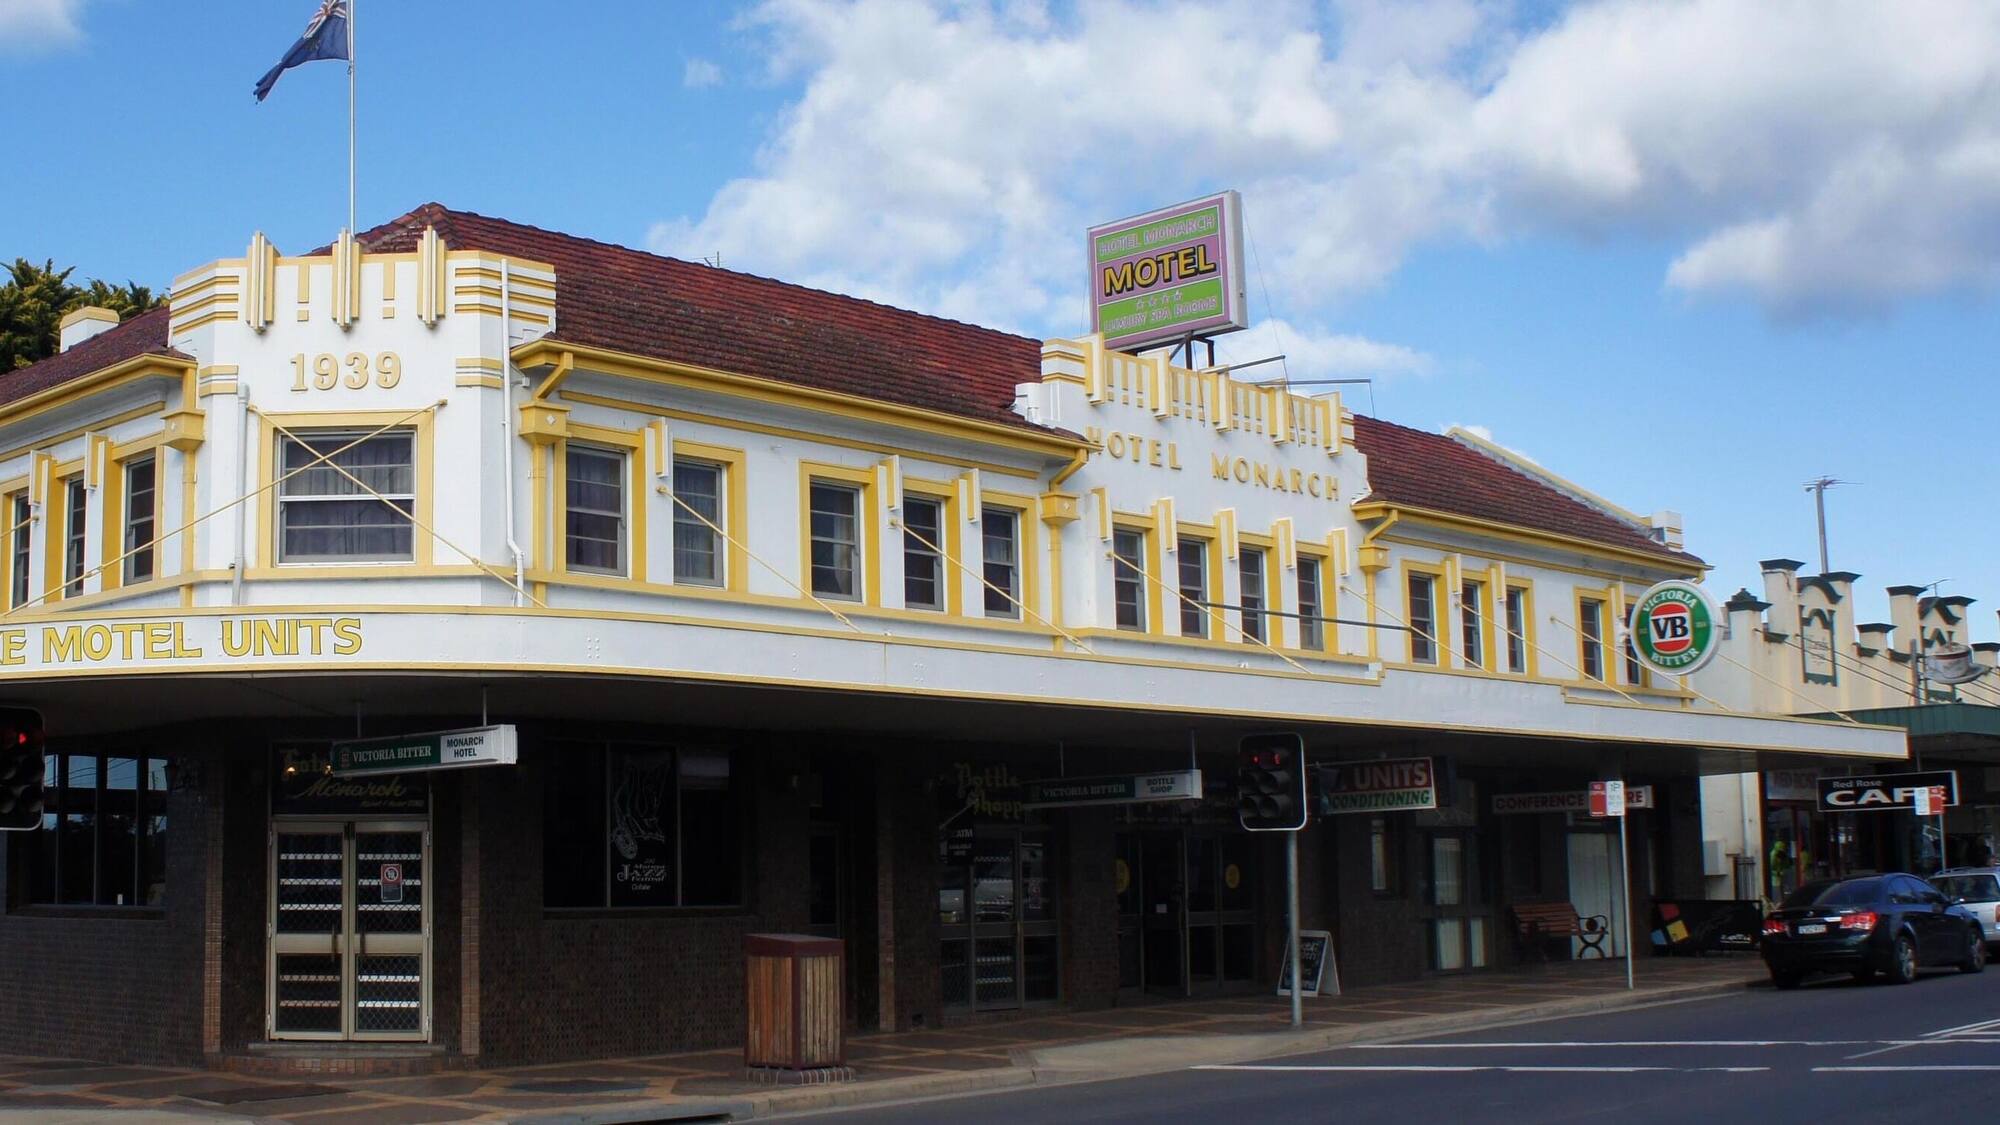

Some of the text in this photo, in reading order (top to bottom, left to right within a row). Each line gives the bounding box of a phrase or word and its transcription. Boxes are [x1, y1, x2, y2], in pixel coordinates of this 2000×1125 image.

[1104, 244, 1217, 298] MOTEL
[290, 350, 401, 391] 1939
[1210, 453, 1339, 501] MONARCH
[1643, 590, 1698, 612] VICTORIA
[1651, 616, 1689, 640] VB
[0, 618, 363, 665] E MOTEL UNITS
[1651, 647, 1700, 666] BITTER
[446, 735, 484, 748] MONARCH
[352, 745, 432, 762] VICTORIA BITTER
[453, 747, 478, 758] HOTEL
[1146, 776, 1176, 786] BOTTLE
[1353, 762, 1428, 789] UNITS
[1833, 779, 1883, 789] Red Rose
[1042, 783, 1125, 797] VICTORIA BITTER
[1149, 785, 1173, 793] SHOP
[1825, 785, 1948, 806] CAF
[965, 787, 1026, 820] Shopp
[1495, 793, 1584, 810] CONFERENCE
